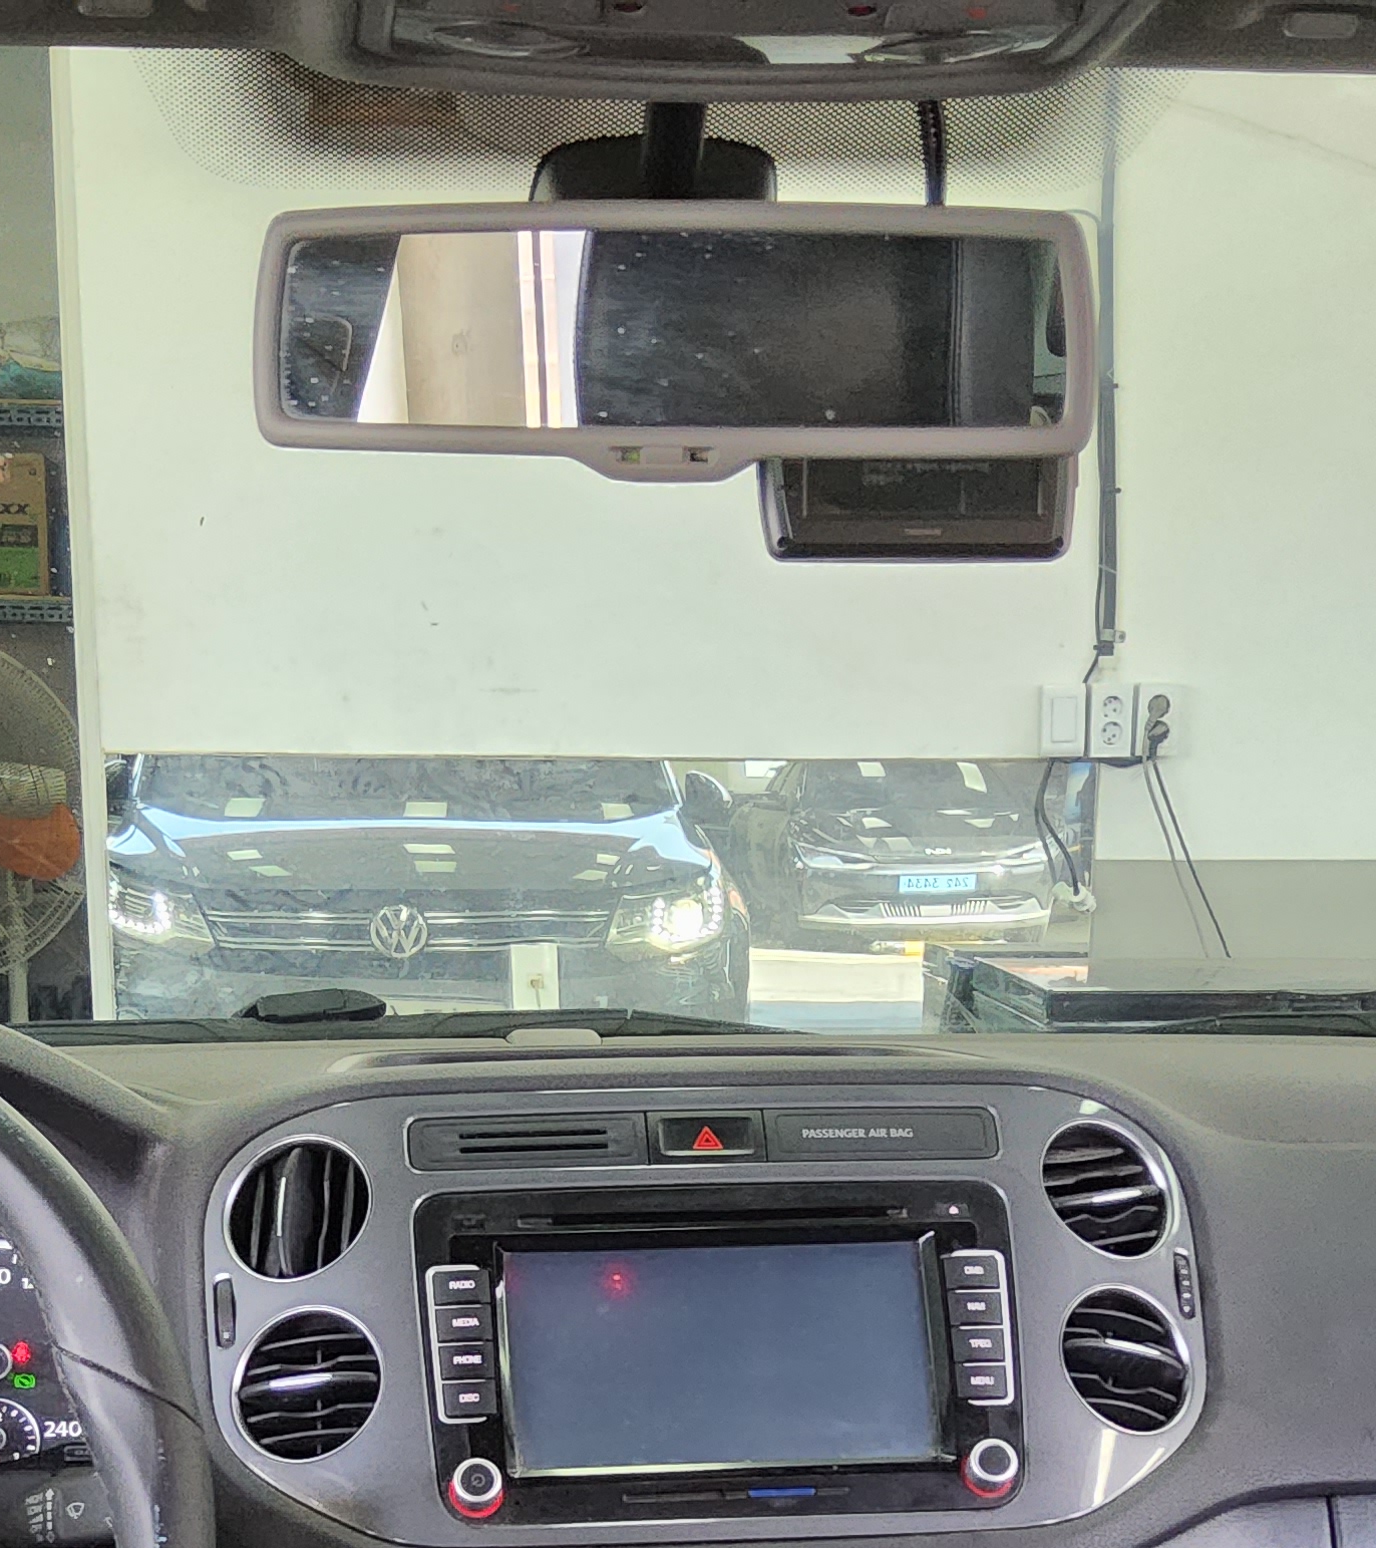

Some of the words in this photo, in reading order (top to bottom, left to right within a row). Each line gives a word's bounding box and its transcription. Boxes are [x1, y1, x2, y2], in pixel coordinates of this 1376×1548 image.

[802, 1127, 867, 1139] PASSENGER
[868, 1127, 888, 1138] AIR
[890, 1127, 914, 1138] BAG
[448, 1280, 476, 1290] RADIO
[451, 1317, 480, 1328] MEDIA
[452, 1355, 482, 1365] PHONE
[970, 1376, 995, 1386] MENU
[43, 1420, 83, 1438] 240
